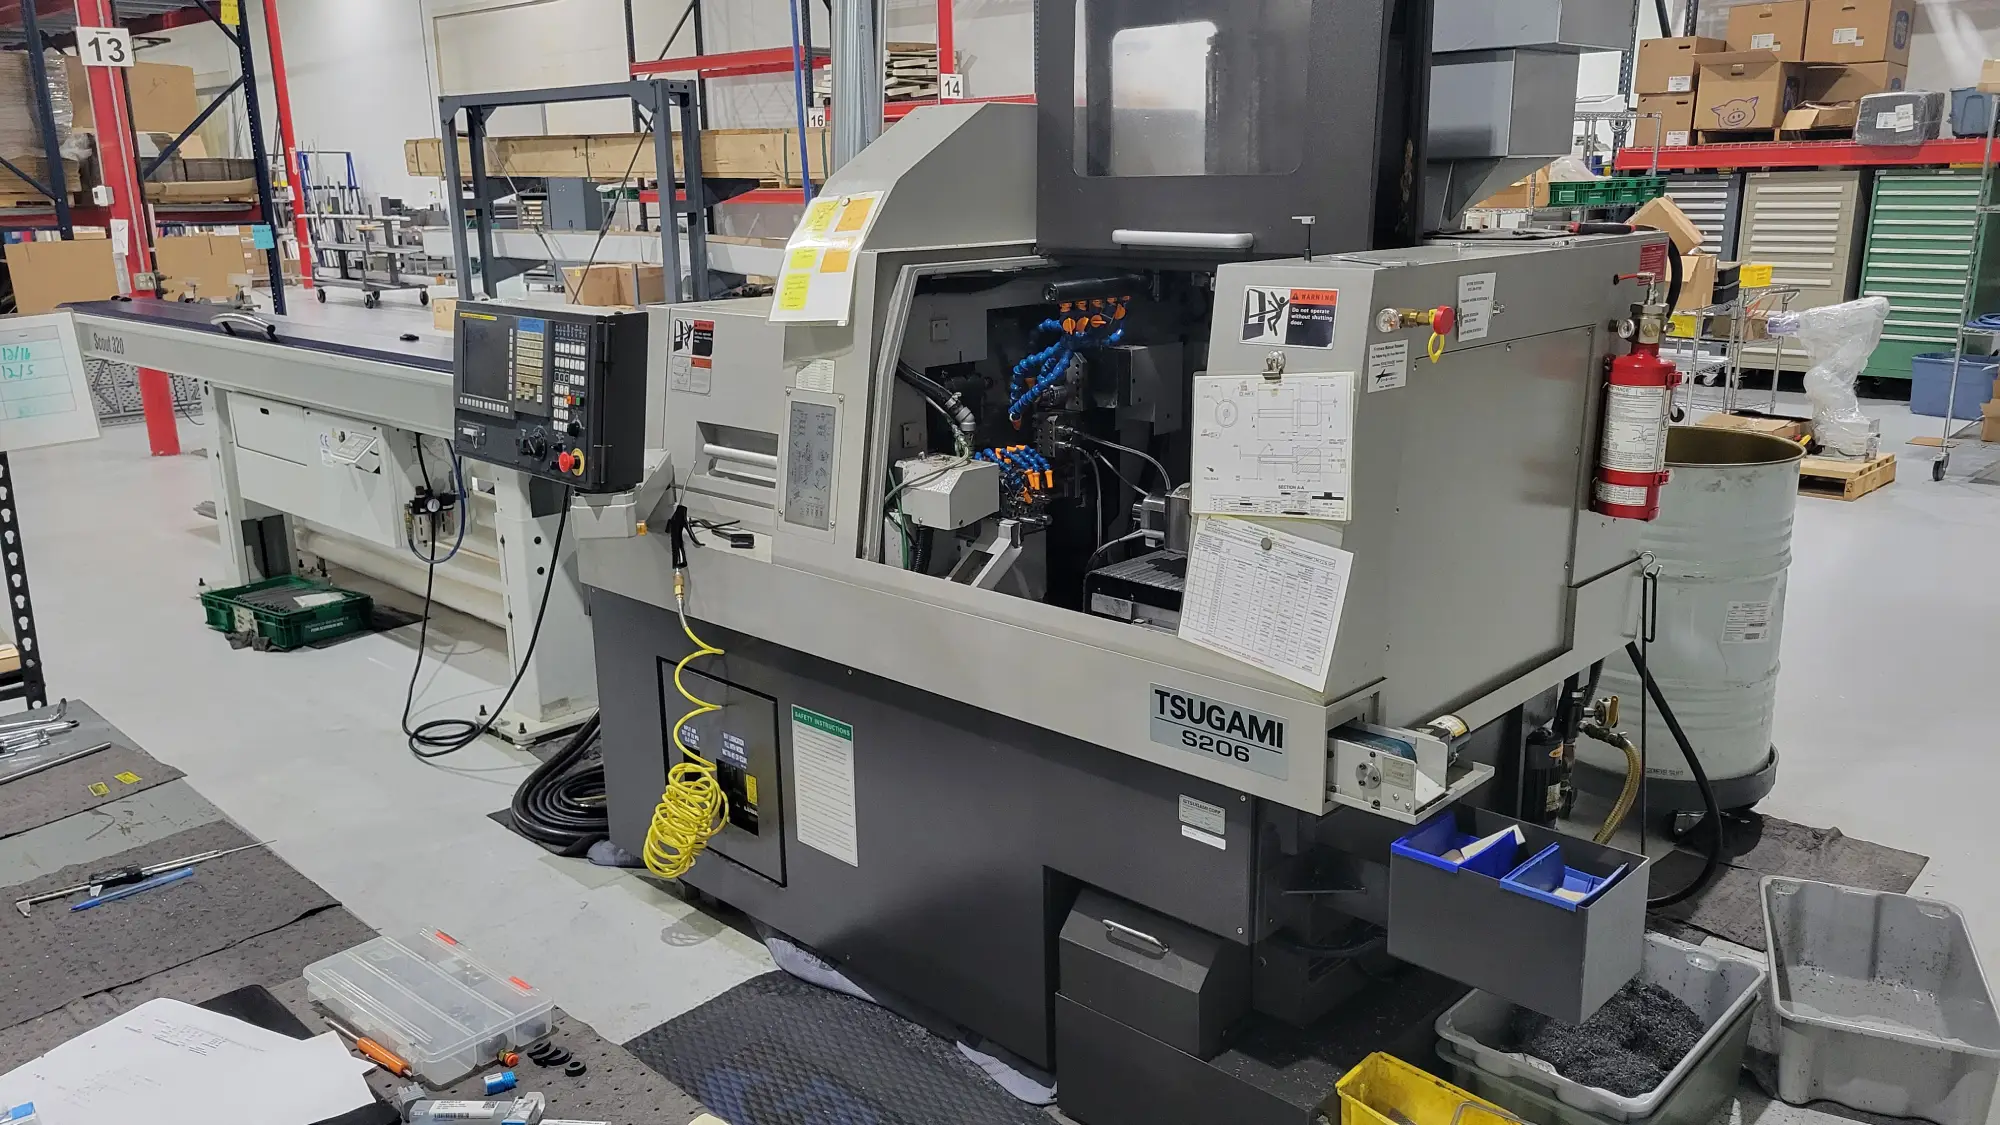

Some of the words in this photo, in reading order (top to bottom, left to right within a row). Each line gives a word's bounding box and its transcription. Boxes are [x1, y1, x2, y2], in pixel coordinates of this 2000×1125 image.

[87, 37, 125, 63] 13
[944, 80, 961, 97] 14
[811, 115, 824, 127] 16
[1301, 294, 1334, 302] WARNING
[93, 332, 111, 352] Scout
[111, 336, 124, 355] 320
[794, 711, 813, 723] SAFETY
[814, 718, 851, 737] INSTRUCTIONS
[1154, 689, 1284, 749] TSUGAMI
[1181, 730, 1250, 762] S206
[1187, 801, 1208, 811] TSUGAMI
